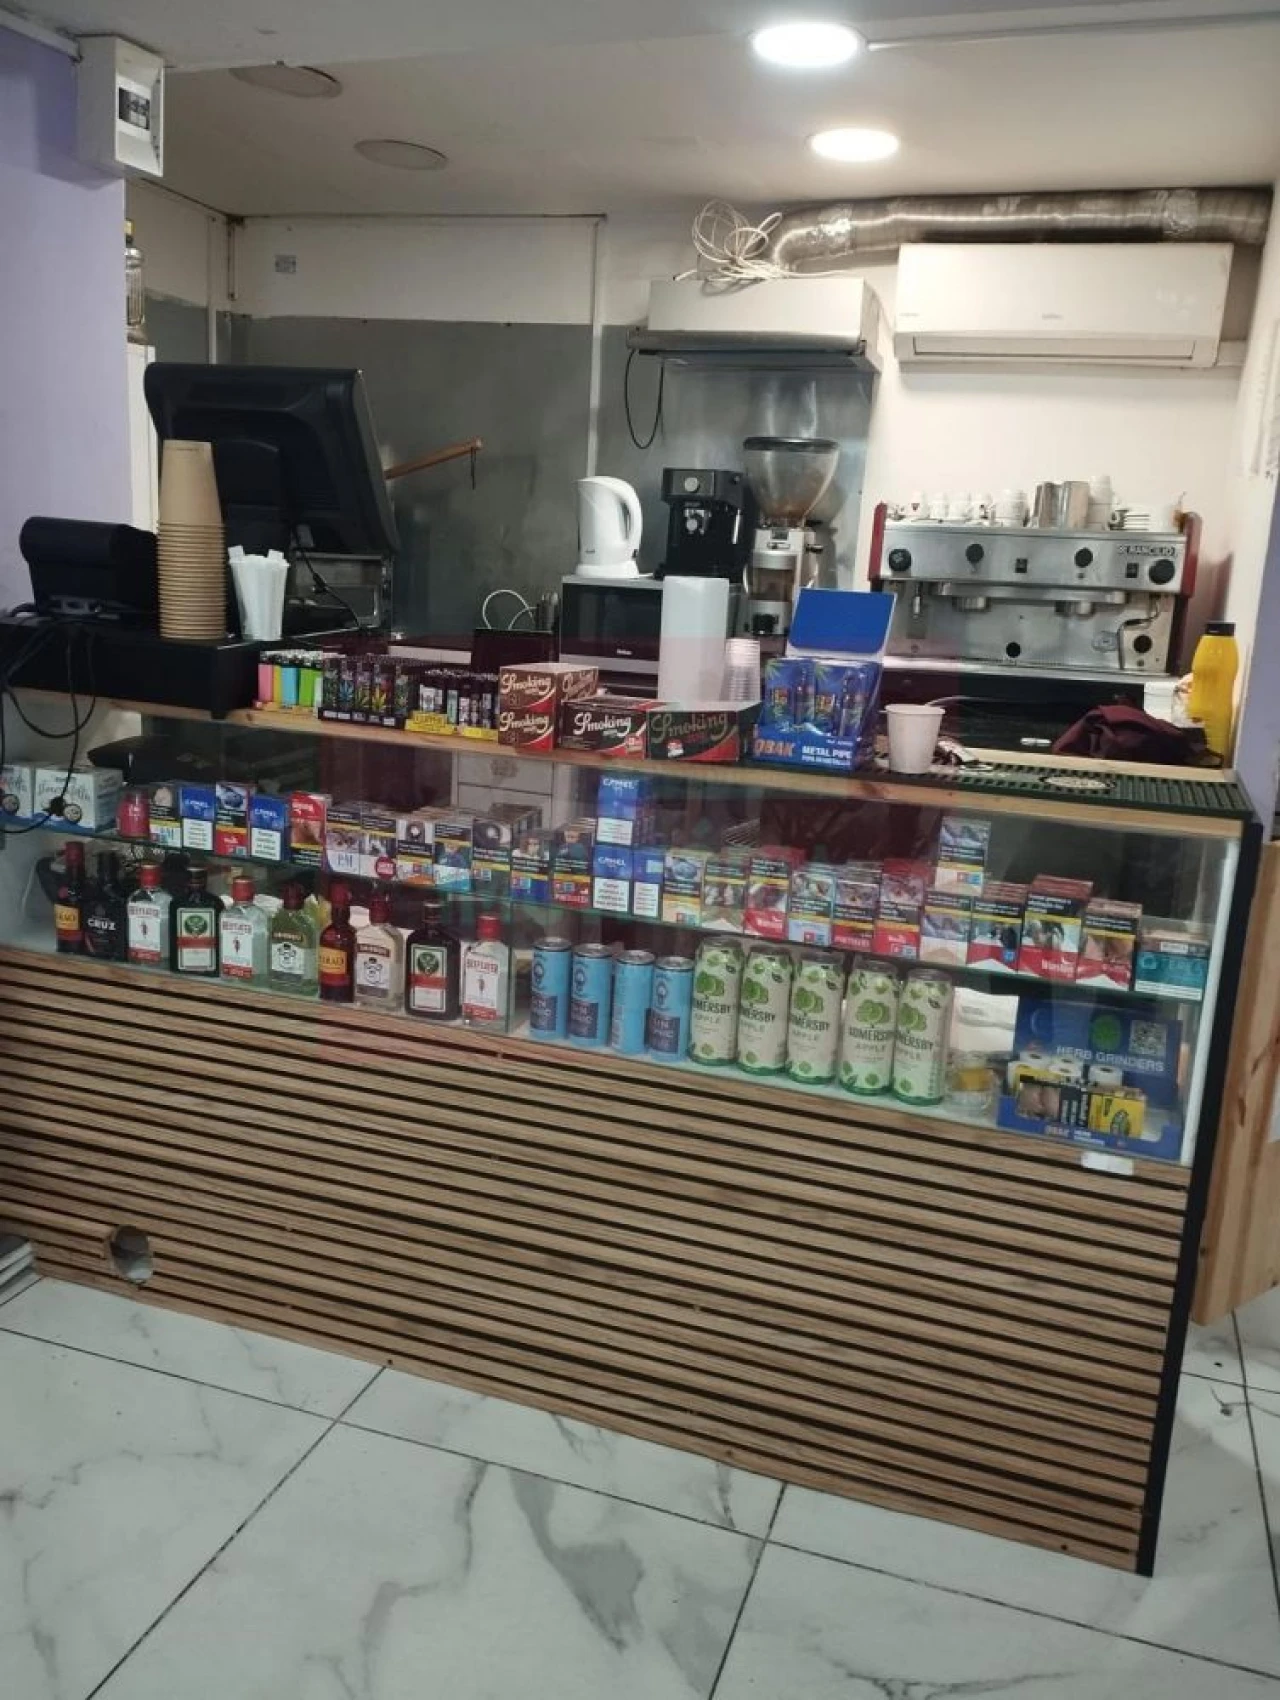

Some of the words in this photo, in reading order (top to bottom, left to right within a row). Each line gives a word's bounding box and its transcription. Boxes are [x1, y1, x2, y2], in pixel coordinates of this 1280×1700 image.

[500, 673, 552, 695] Smoking
[500, 712, 550, 734] Smoking
[573, 712, 632, 737] Smoking
[650, 712, 729, 744] Smoking
[801, 745, 831, 756] METAL
[832, 749, 852, 759] PIPE
[1056, 1045, 1092, 1061] HERB
[1096, 1052, 1165, 1073] GRINDERS
